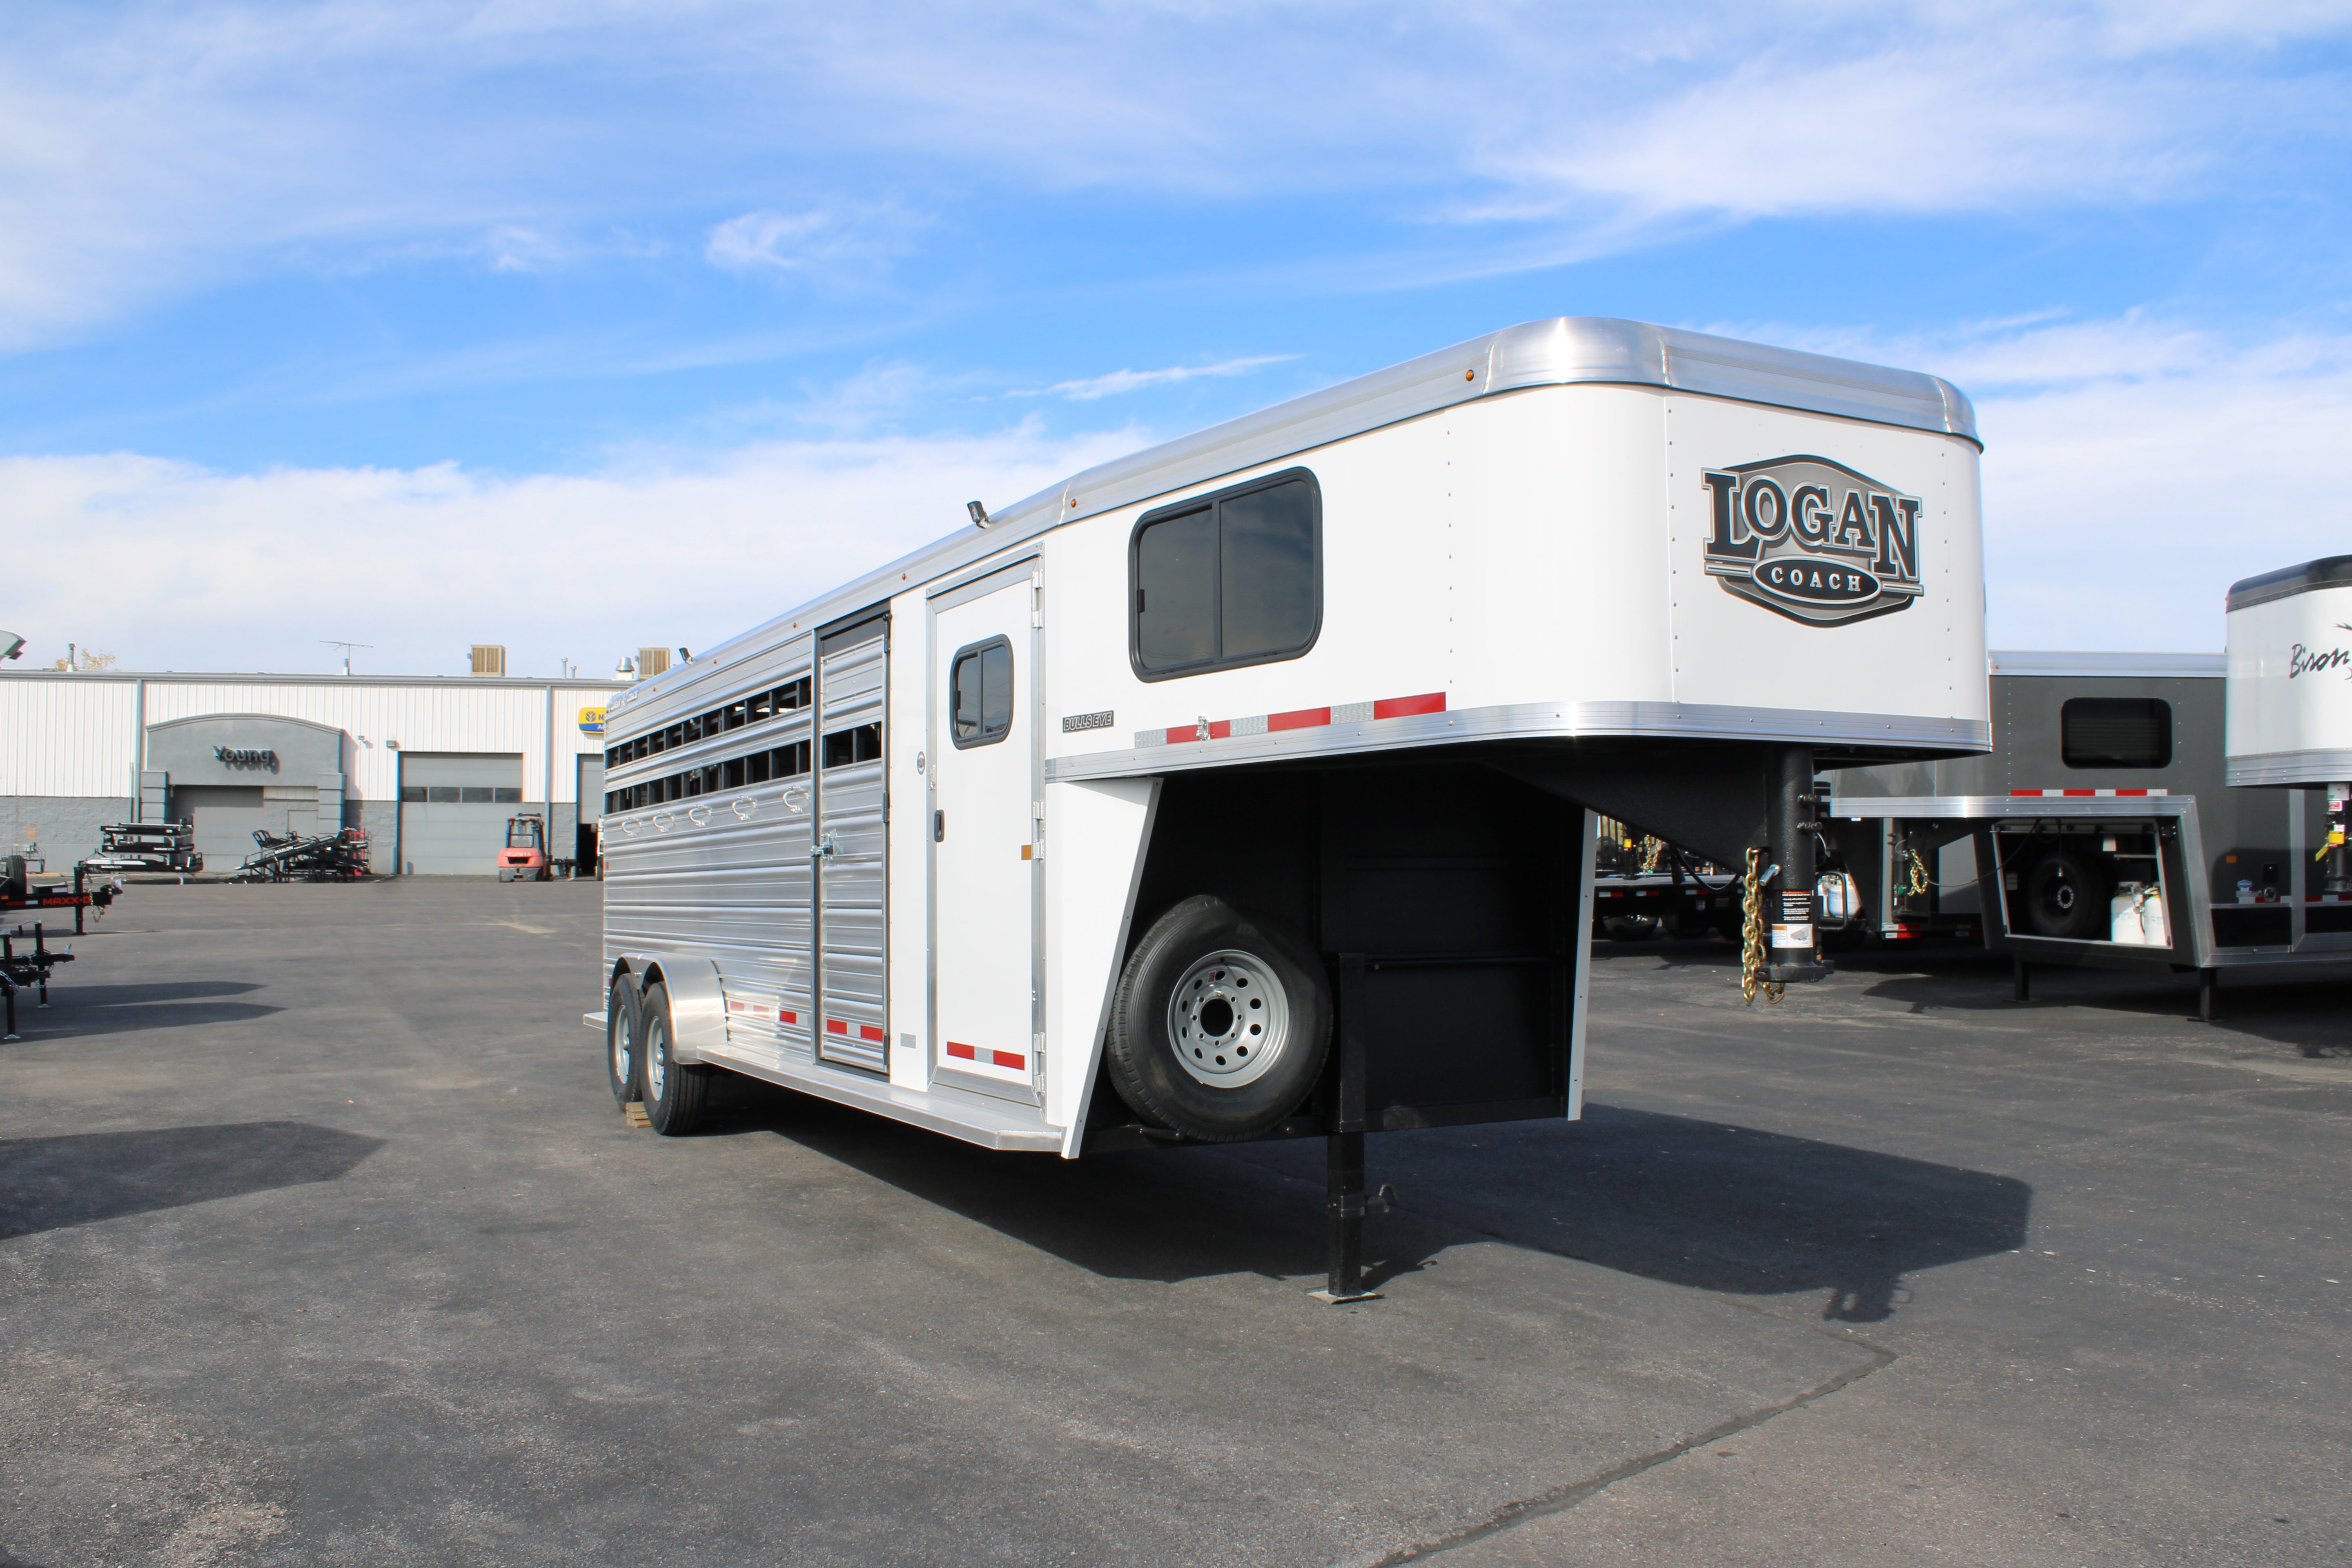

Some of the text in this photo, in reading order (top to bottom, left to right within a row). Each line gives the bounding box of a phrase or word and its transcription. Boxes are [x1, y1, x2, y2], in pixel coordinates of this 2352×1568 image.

[1701, 467, 1922, 582] LOGAN
[1771, 566, 1862, 592] COACH
[2289, 643, 2351, 679] Bison
[1064, 712, 1112, 731] BULLSEYE
[212, 745, 271, 765] Young
[42, 895, 91, 906] MAXX-D
